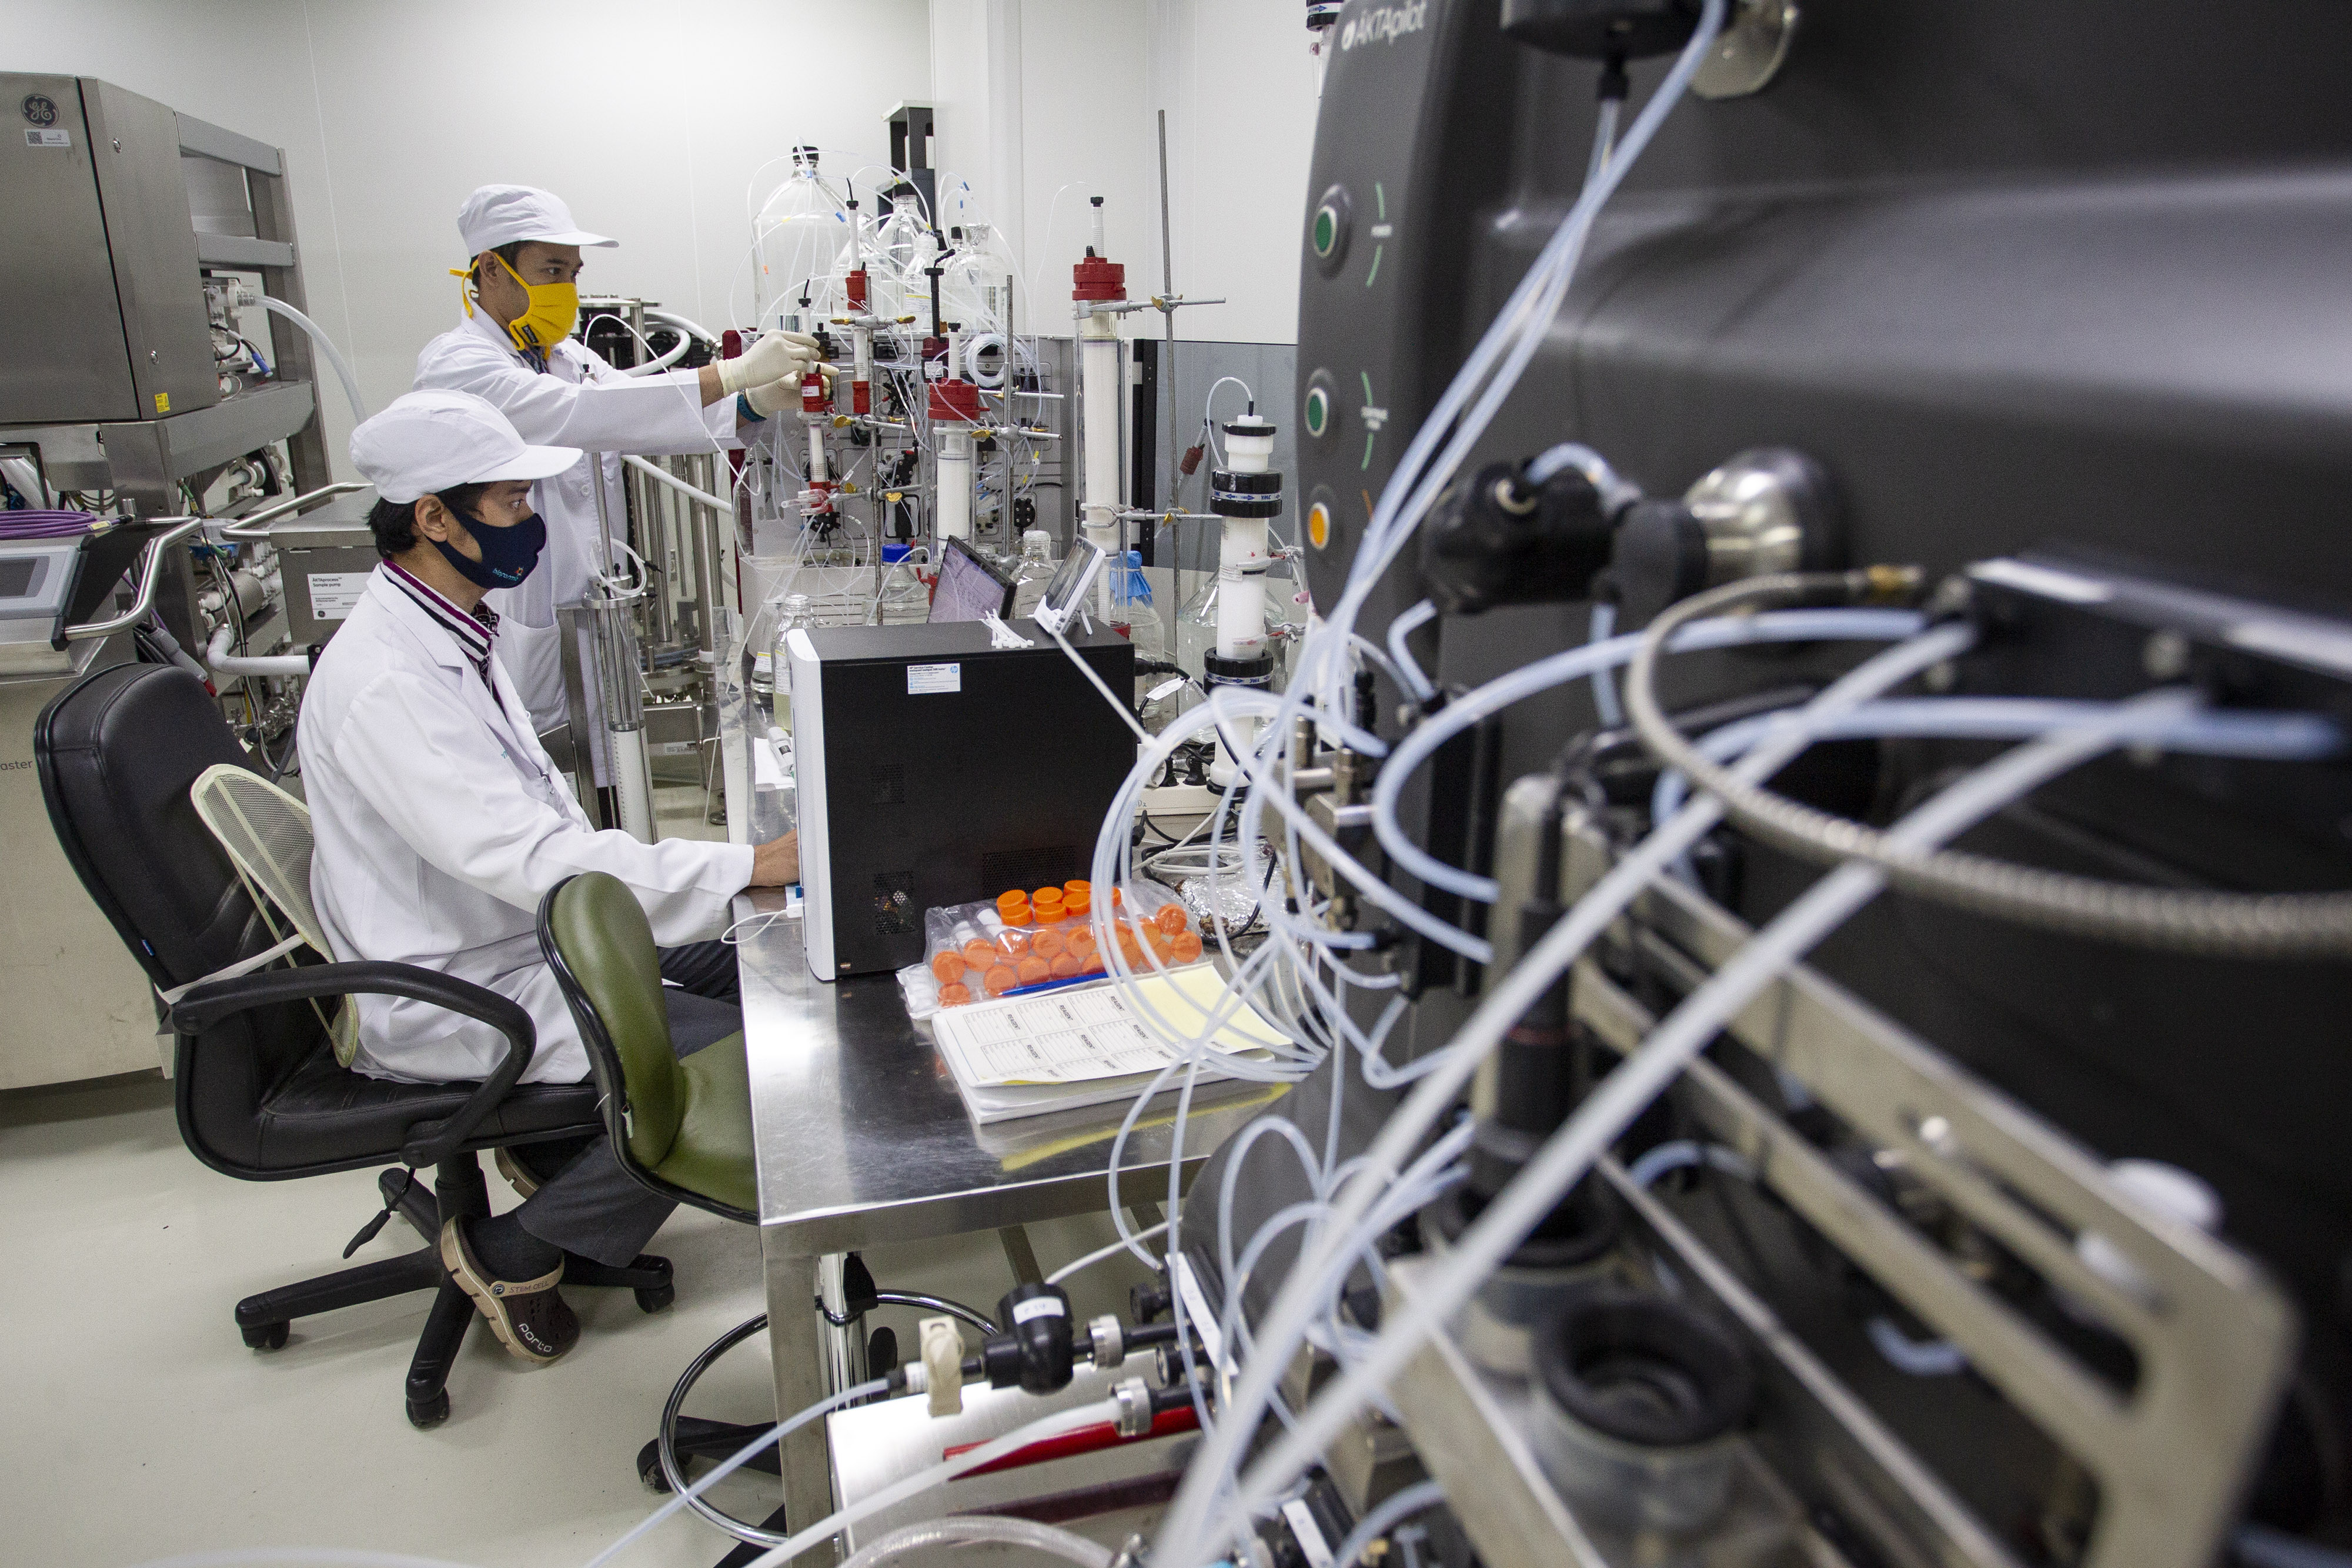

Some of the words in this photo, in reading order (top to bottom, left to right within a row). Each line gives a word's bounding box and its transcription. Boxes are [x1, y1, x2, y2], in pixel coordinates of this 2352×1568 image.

[1110, 995, 1125, 1012] REAGENT
[1058, 1005, 1074, 1021] REAGENT
[1006, 1014, 1021, 1031] REAGENT
[1132, 1024, 1149, 1040] REAGENT
[1080, 1034, 1096, 1051] REAGENT
[1026, 1044, 1042, 1059] REAGENT
[533, 1281, 549, 1289] CELL
